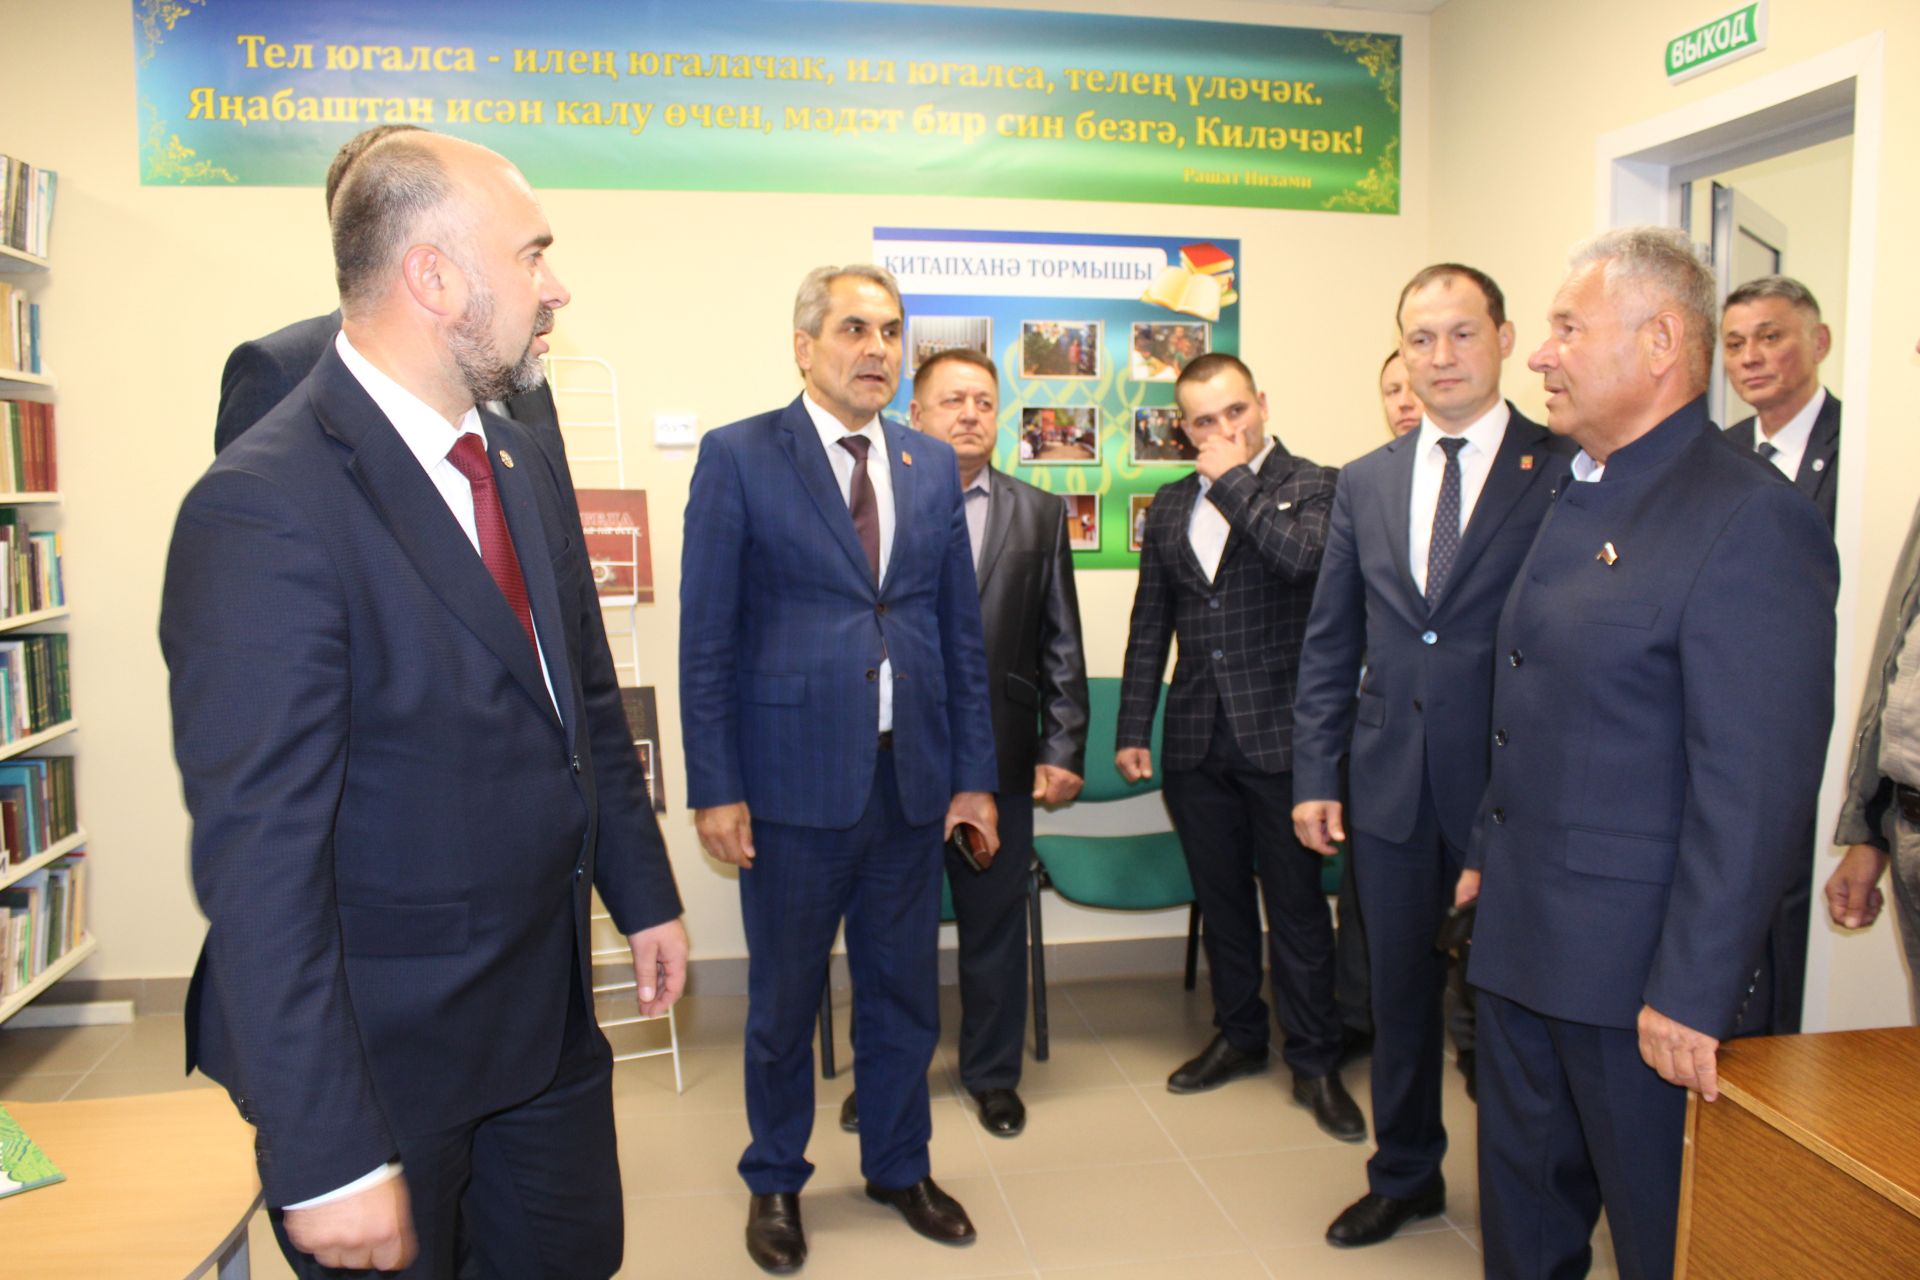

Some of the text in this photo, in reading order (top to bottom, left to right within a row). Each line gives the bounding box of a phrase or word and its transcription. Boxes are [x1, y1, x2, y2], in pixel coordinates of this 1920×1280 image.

[237, 35, 313, 69] Тел
[325, 44, 476, 72] югалса
[512, 48, 619, 81] илең
[627, 51, 835, 86] югалачак,
[846, 58, 896, 83] ил
[906, 60, 1055, 95] югалса,
[1064, 68, 1176, 102] телең
[1184, 74, 1322, 106] үләчәк.
[1671, 11, 1749, 69] ВЫХОД
[187, 87, 1363, 155] Яңабаштан исән калу өчен, мәдәт бир син безгә, Киләчәк!
[884, 256, 1152, 280] КИТАПХАНӘ ТОРМЫШЫ
